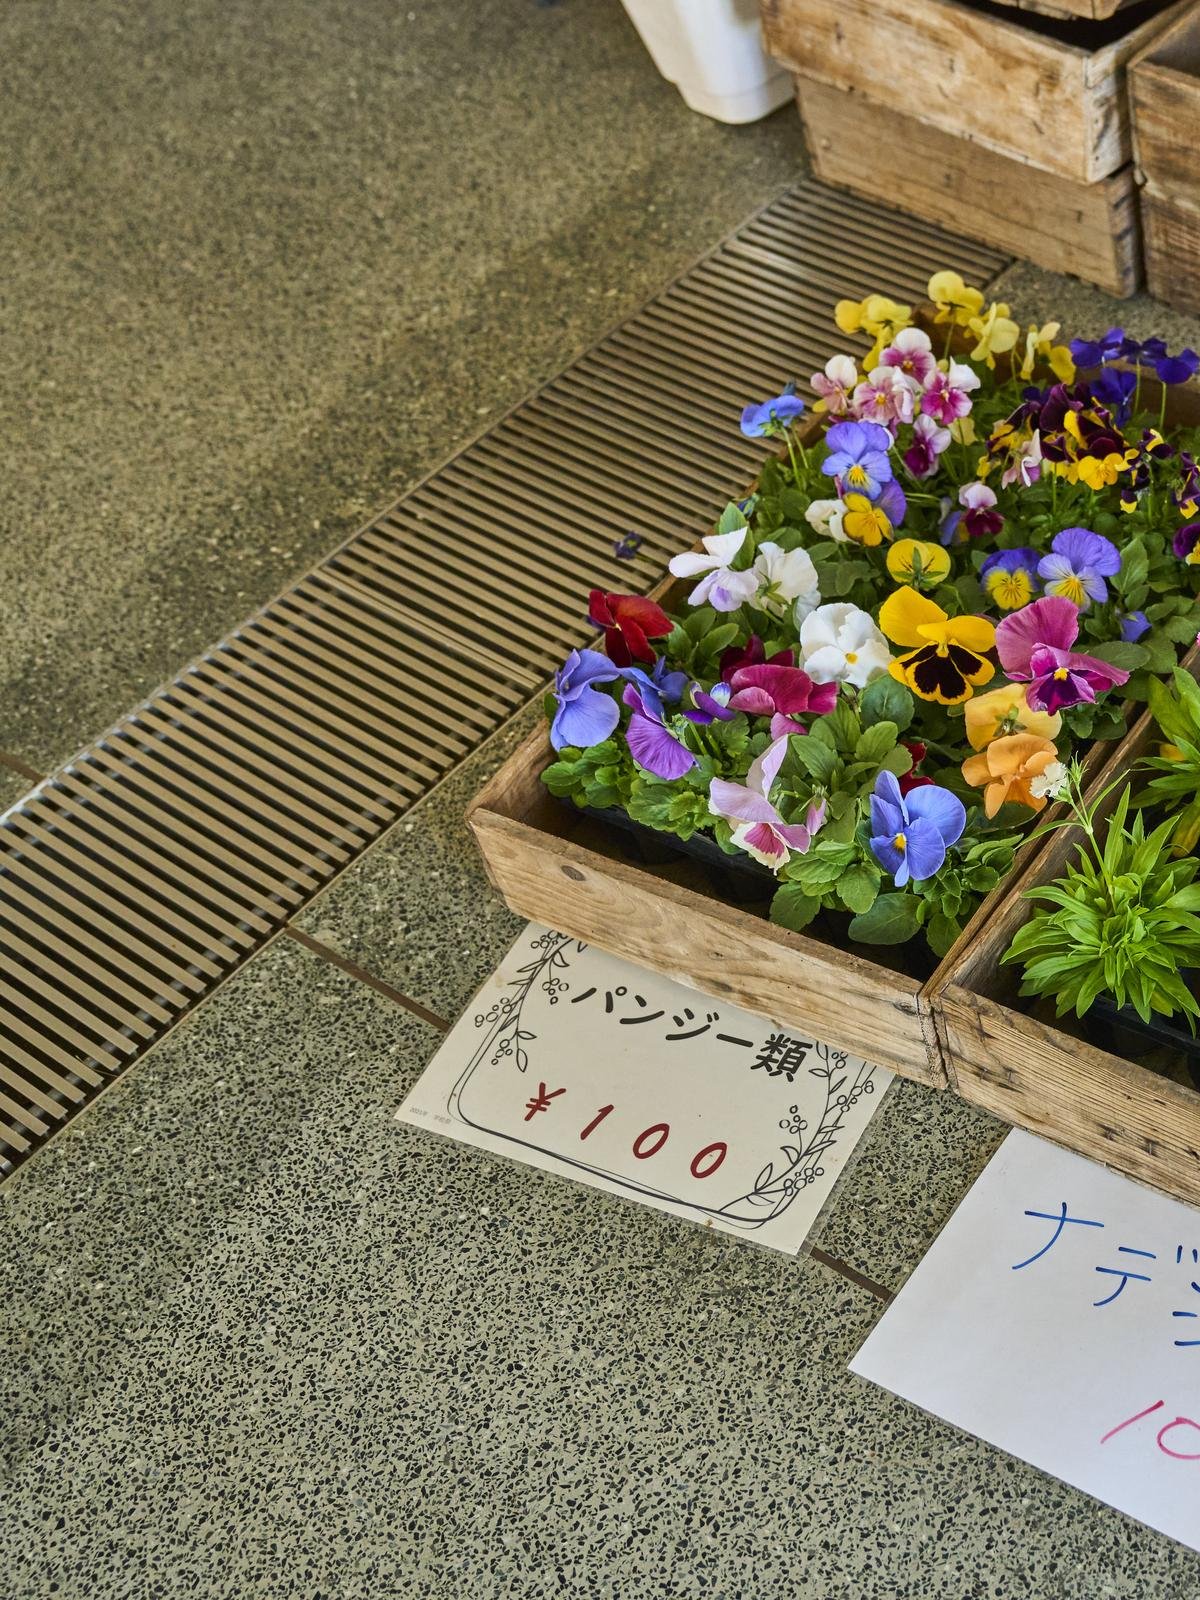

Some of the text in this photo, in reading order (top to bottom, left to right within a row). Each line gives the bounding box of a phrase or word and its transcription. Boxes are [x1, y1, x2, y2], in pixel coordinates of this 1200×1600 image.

[571, 985, 813, 1082] パンジー類
